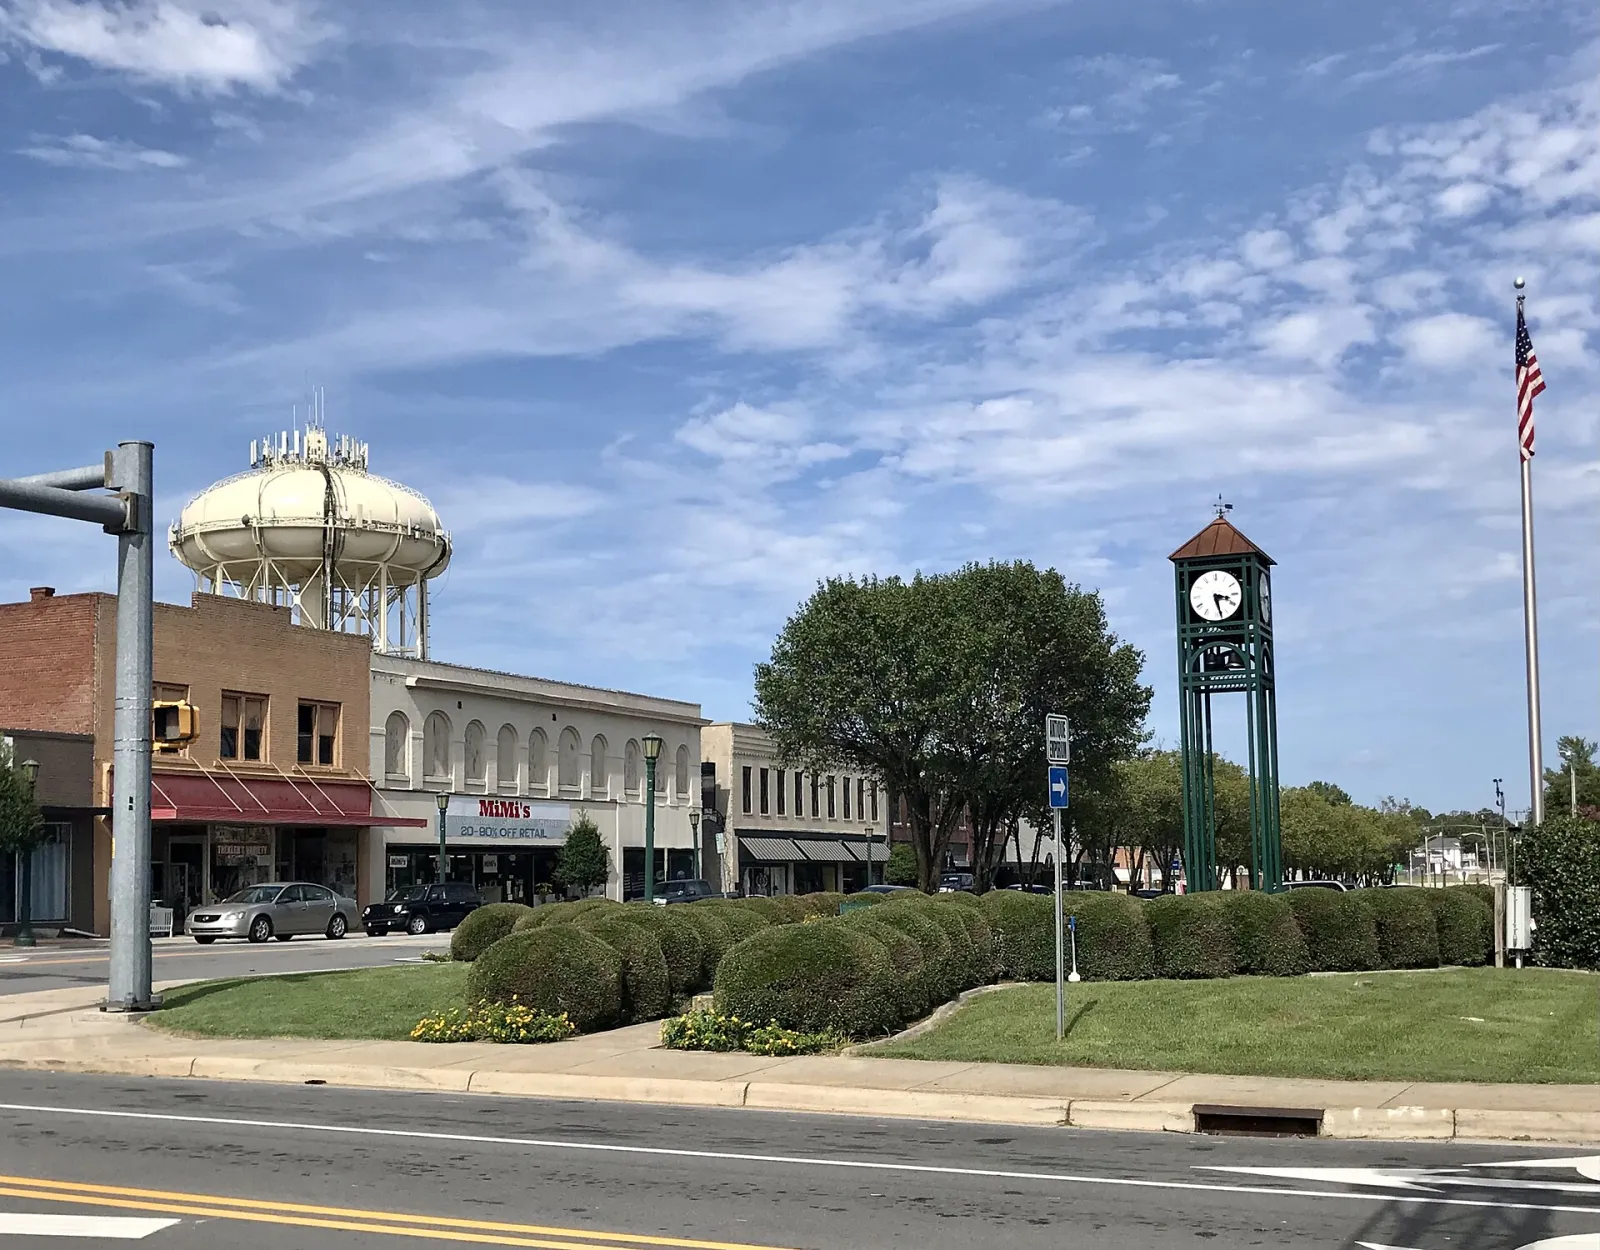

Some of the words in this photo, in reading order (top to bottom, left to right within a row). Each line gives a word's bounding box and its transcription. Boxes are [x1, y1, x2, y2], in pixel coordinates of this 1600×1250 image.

[479, 800, 531, 818] MiMi's
[499, 828, 518, 837] OFF
[520, 829, 547, 838] RETAIL
